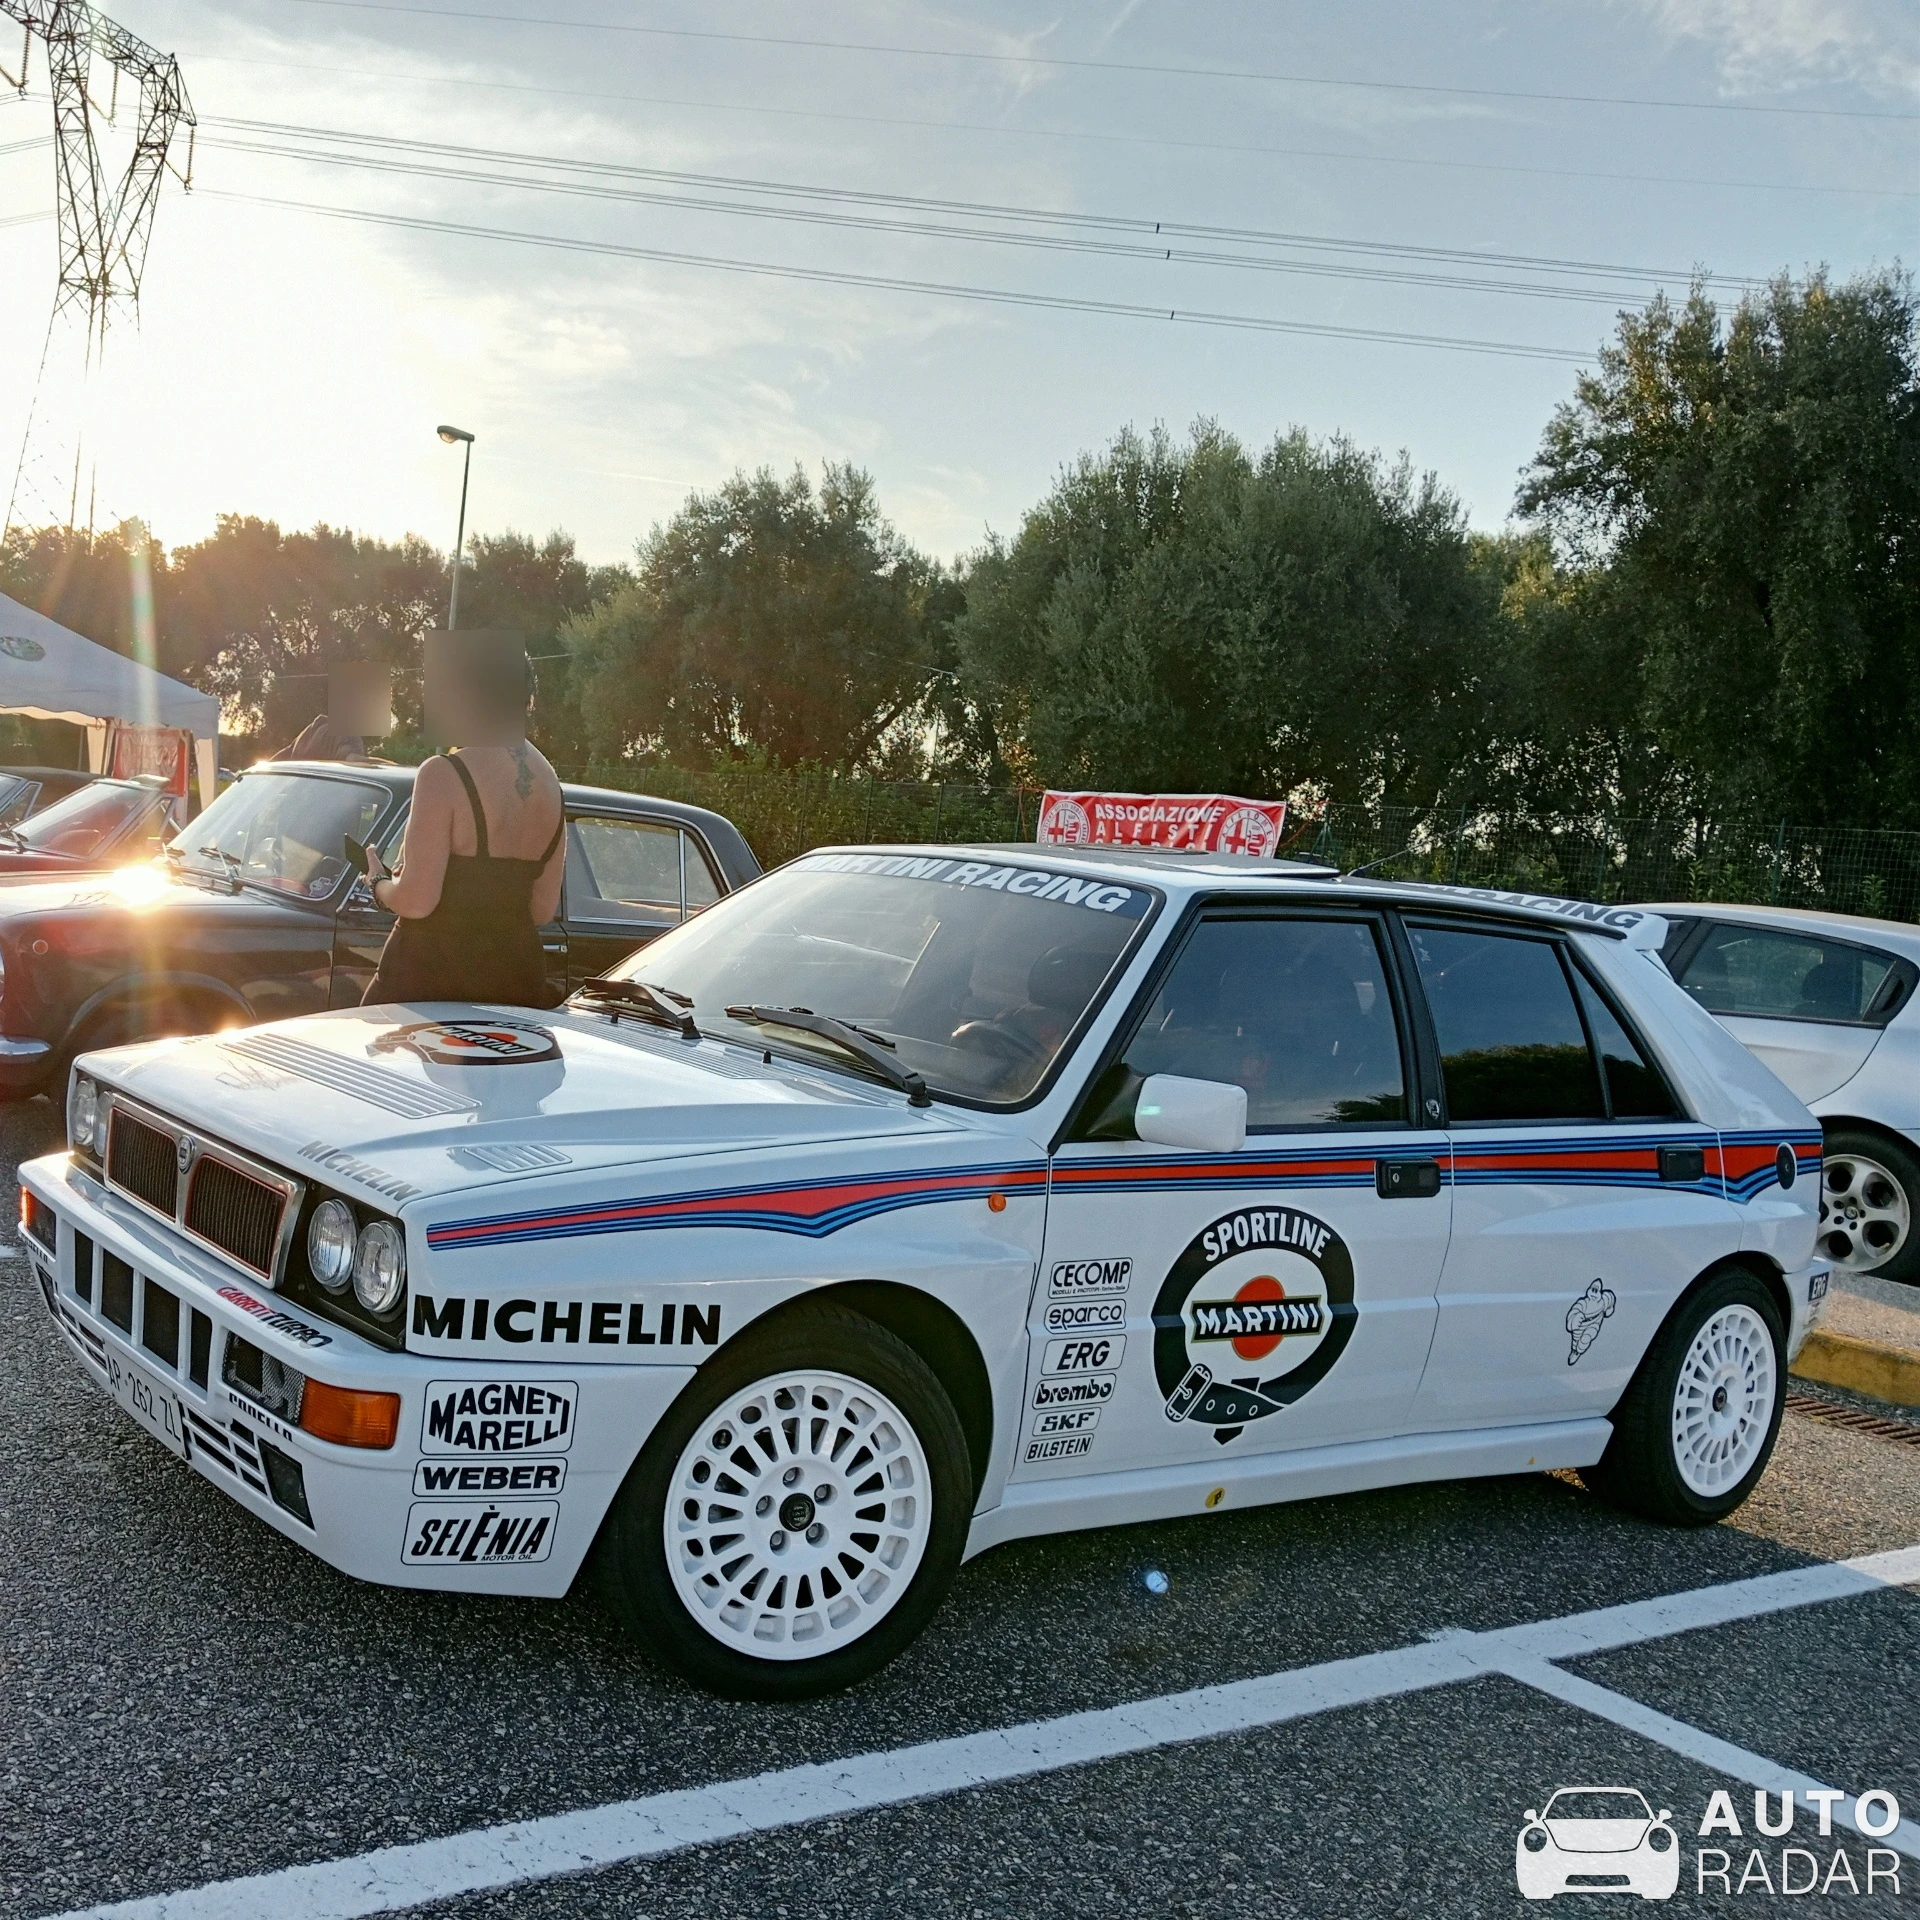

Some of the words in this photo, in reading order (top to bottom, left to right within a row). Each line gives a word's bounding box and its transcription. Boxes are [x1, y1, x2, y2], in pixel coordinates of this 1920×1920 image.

[1095, 803, 1226, 823] ASSOCIAZIONE
[1095, 820, 1213, 841] ALFISTI
[789, 854, 955, 880] MARTINI
[942, 862, 1132, 913] RACING
[435, 1026, 527, 1054] MARTINI
[297, 1140, 422, 1201] MICHELIN
[1203, 1212, 1331, 1262] SPORTLINE
[1053, 1261, 1130, 1287] CECOMP
[412, 1294, 721, 1345] MICHELIN
[1049, 1305, 1122, 1330] sparco
[1196, 1303, 1319, 1335] MARTINI
[1056, 1341, 1110, 1370] ERG
[107, 1354, 121, 1391] AP
[128, 1372, 158, 1423] 262
[429, 1384, 570, 1420] MAGNETI
[1035, 1379, 1112, 1405] brembo
[429, 1414, 570, 1451] MARELLI
[1041, 1412, 1095, 1432] SKF
[1027, 1437, 1091, 1460] BILSTEIN
[422, 1465, 560, 1490] WEBER
[411, 1504, 550, 1562] SELÈNIA
[481, 1554, 515, 1562] MOTOR
[518, 1553, 533, 1561] OIL
